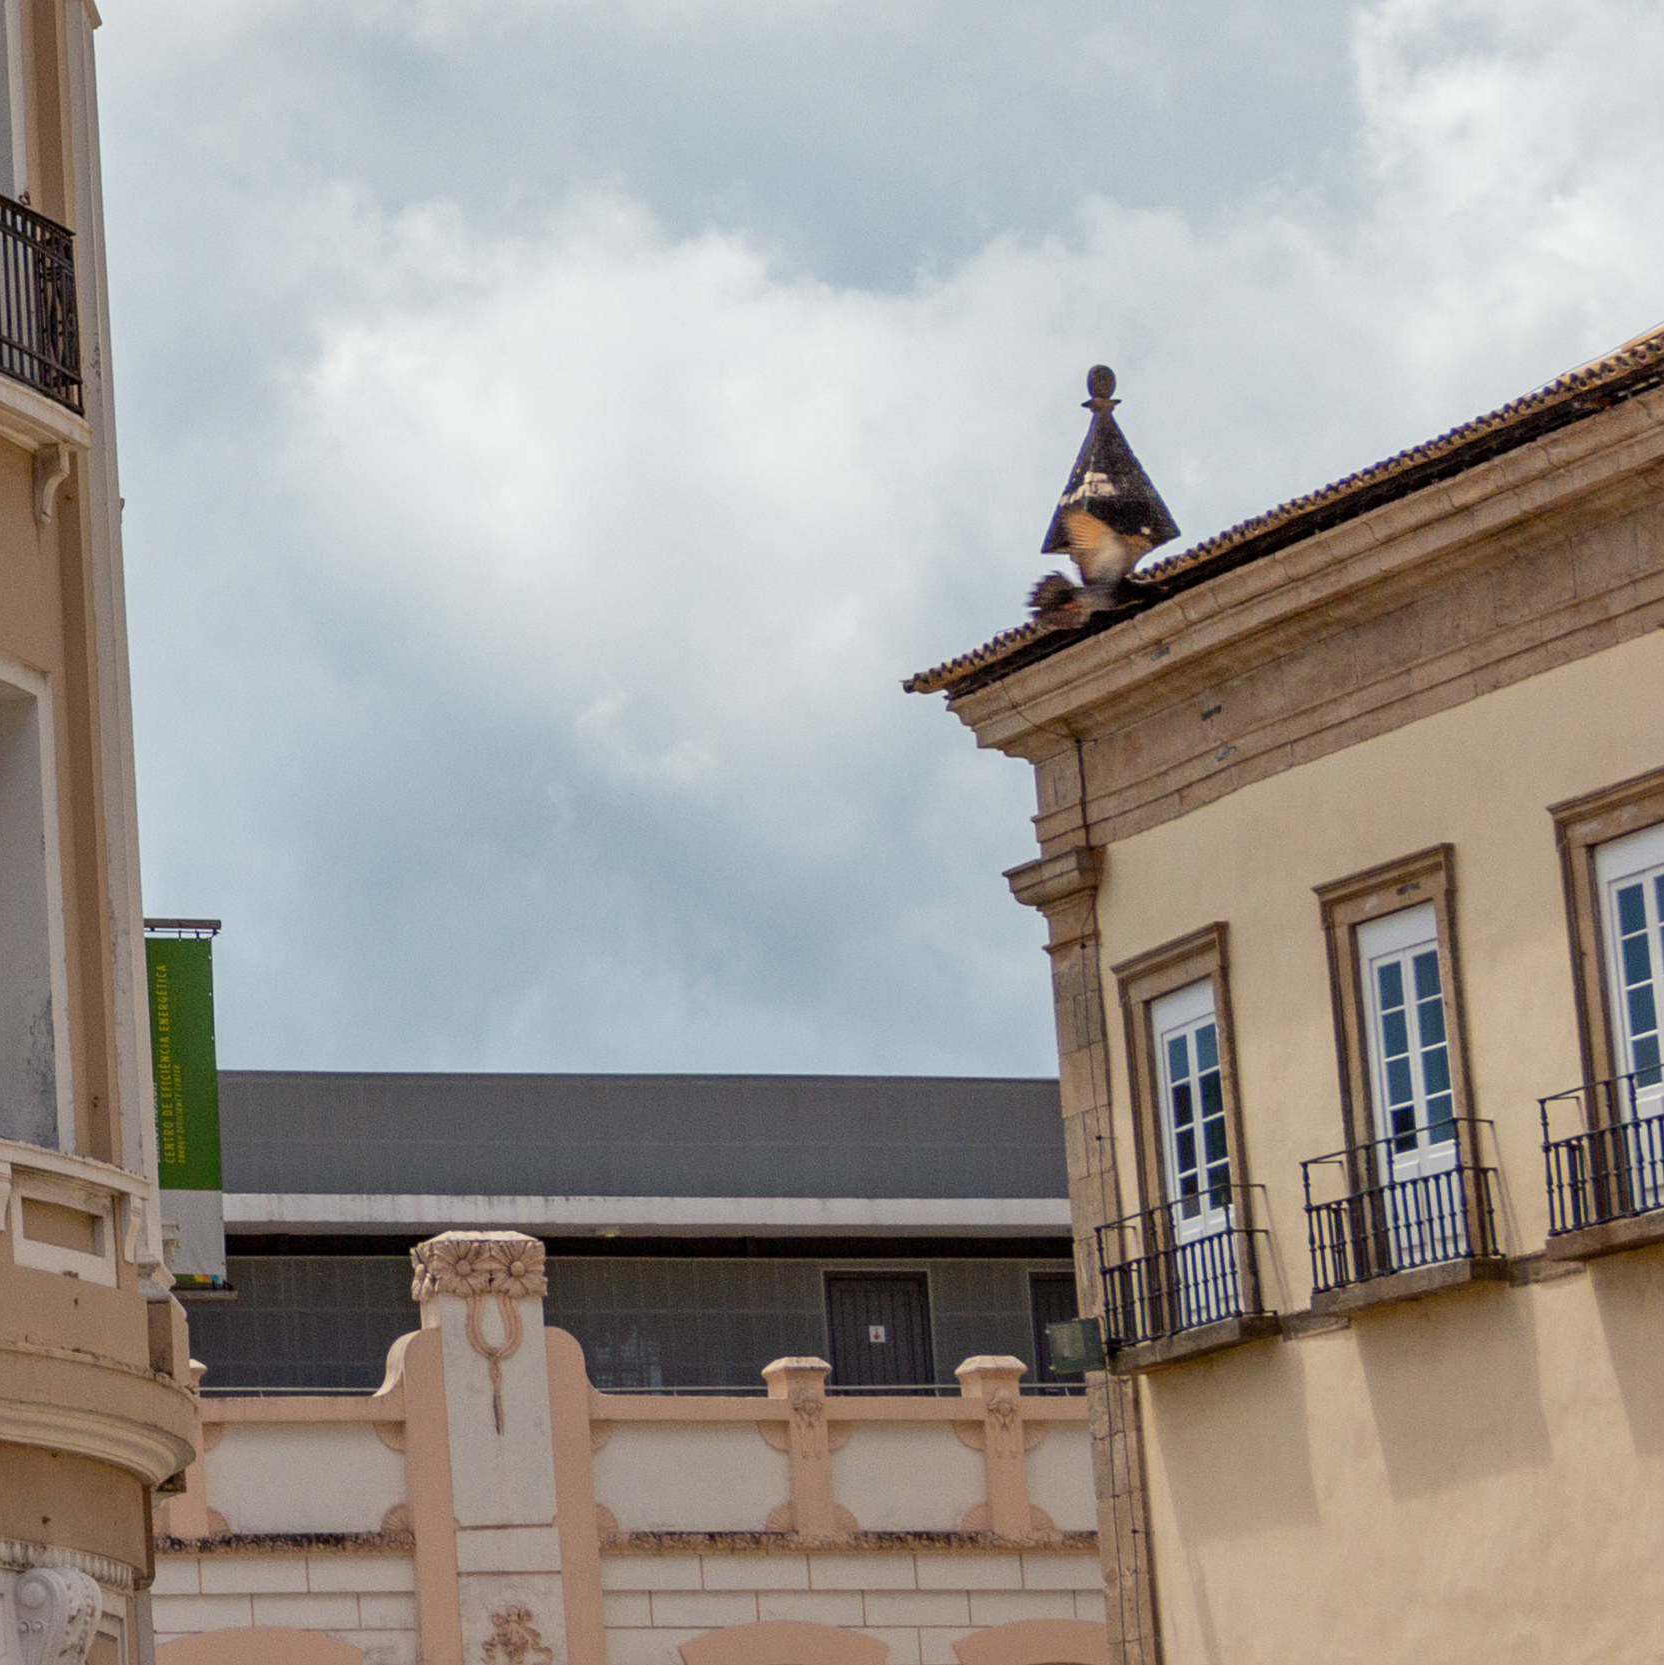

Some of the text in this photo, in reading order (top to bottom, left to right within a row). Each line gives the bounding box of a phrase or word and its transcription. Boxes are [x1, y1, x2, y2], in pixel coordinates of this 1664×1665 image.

[155, 964, 176, 1164] CENTRO DE EFICIÊNCIA ENERGÉTICA
